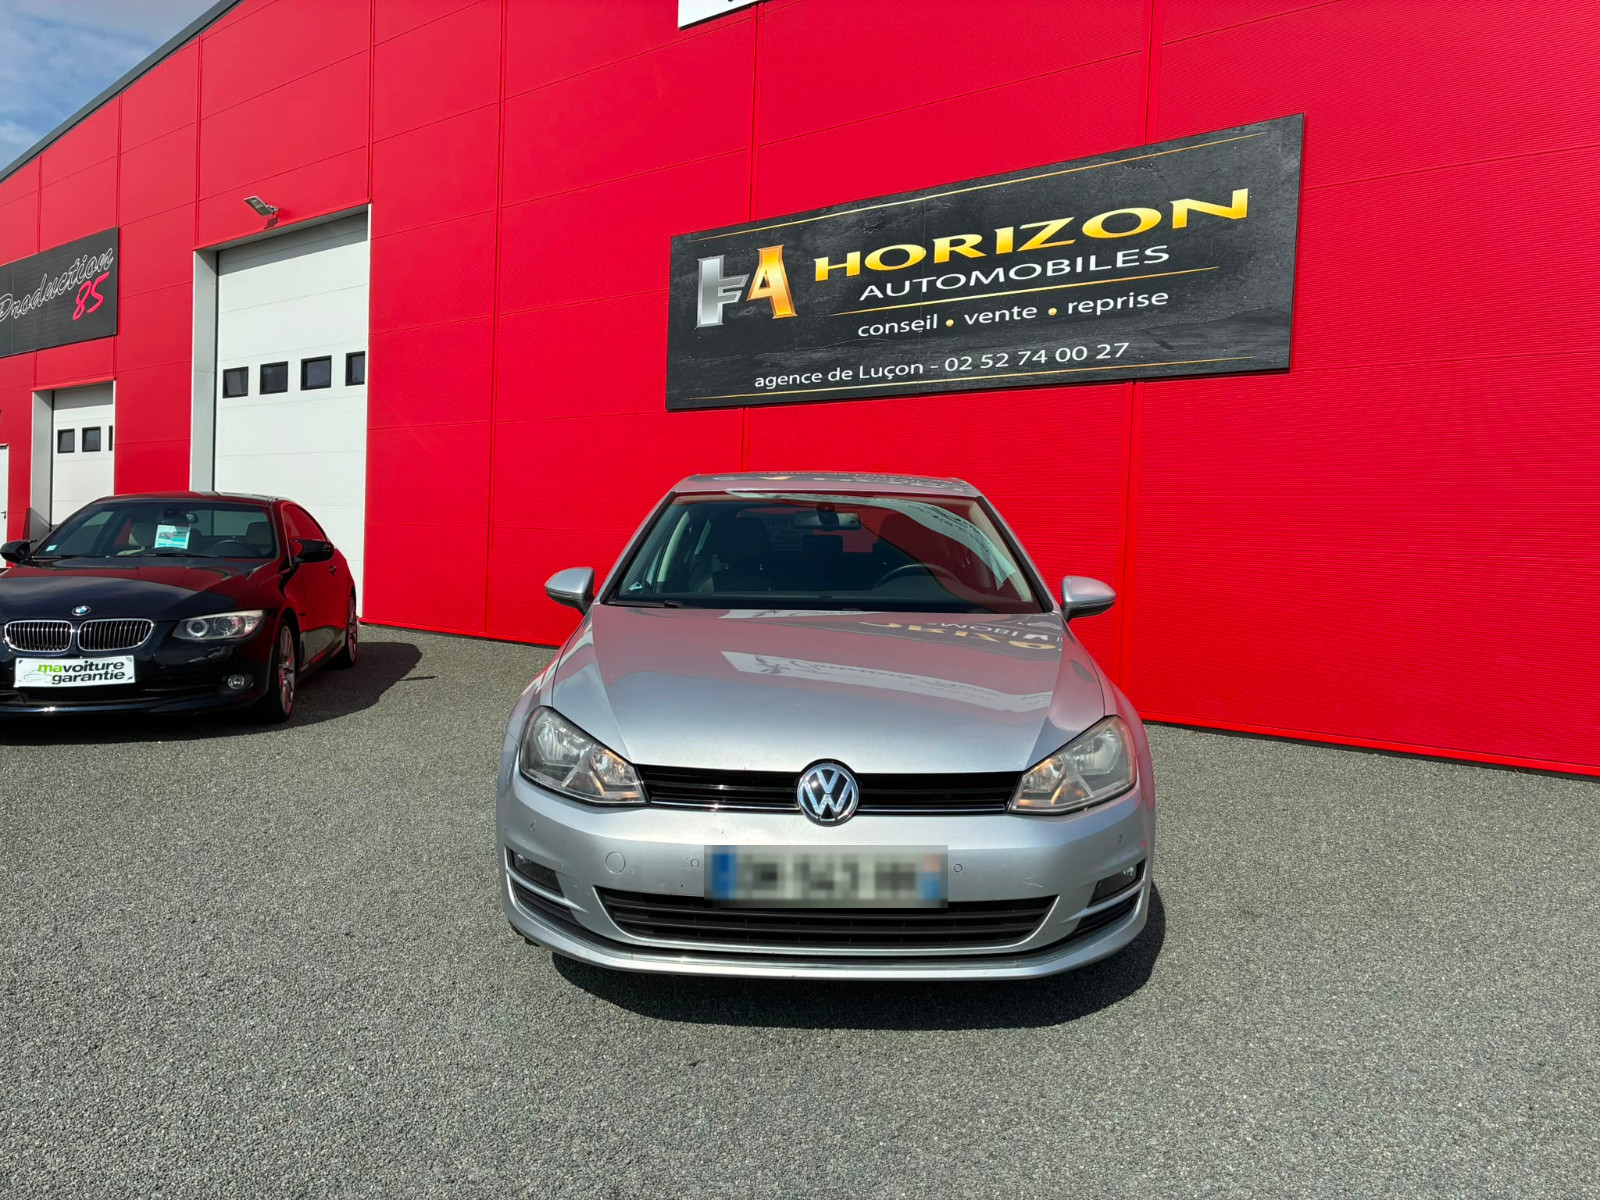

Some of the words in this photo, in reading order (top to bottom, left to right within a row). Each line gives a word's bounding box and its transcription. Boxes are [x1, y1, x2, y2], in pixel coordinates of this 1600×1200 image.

[814, 188, 1249, 282] HORIZON
[72, 271, 110, 320] 85
[859, 245, 1170, 301] AUTOMOBILES
[857, 314, 937, 337] conseil
[964, 305, 1038, 325] vente
[1067, 292, 1169, 315] reprise
[754, 372, 823, 389] agence
[827, 367, 853, 381] de
[859, 363, 924, 380] Luçon
[944, 356, 973, 372] 02
[979, 353, 1010, 369] 52
[1017, 349, 1048, 366] 74
[1055, 346, 1088, 363] 00
[1095, 342, 1130, 359] 27
[52, 670, 126, 684] garantie
